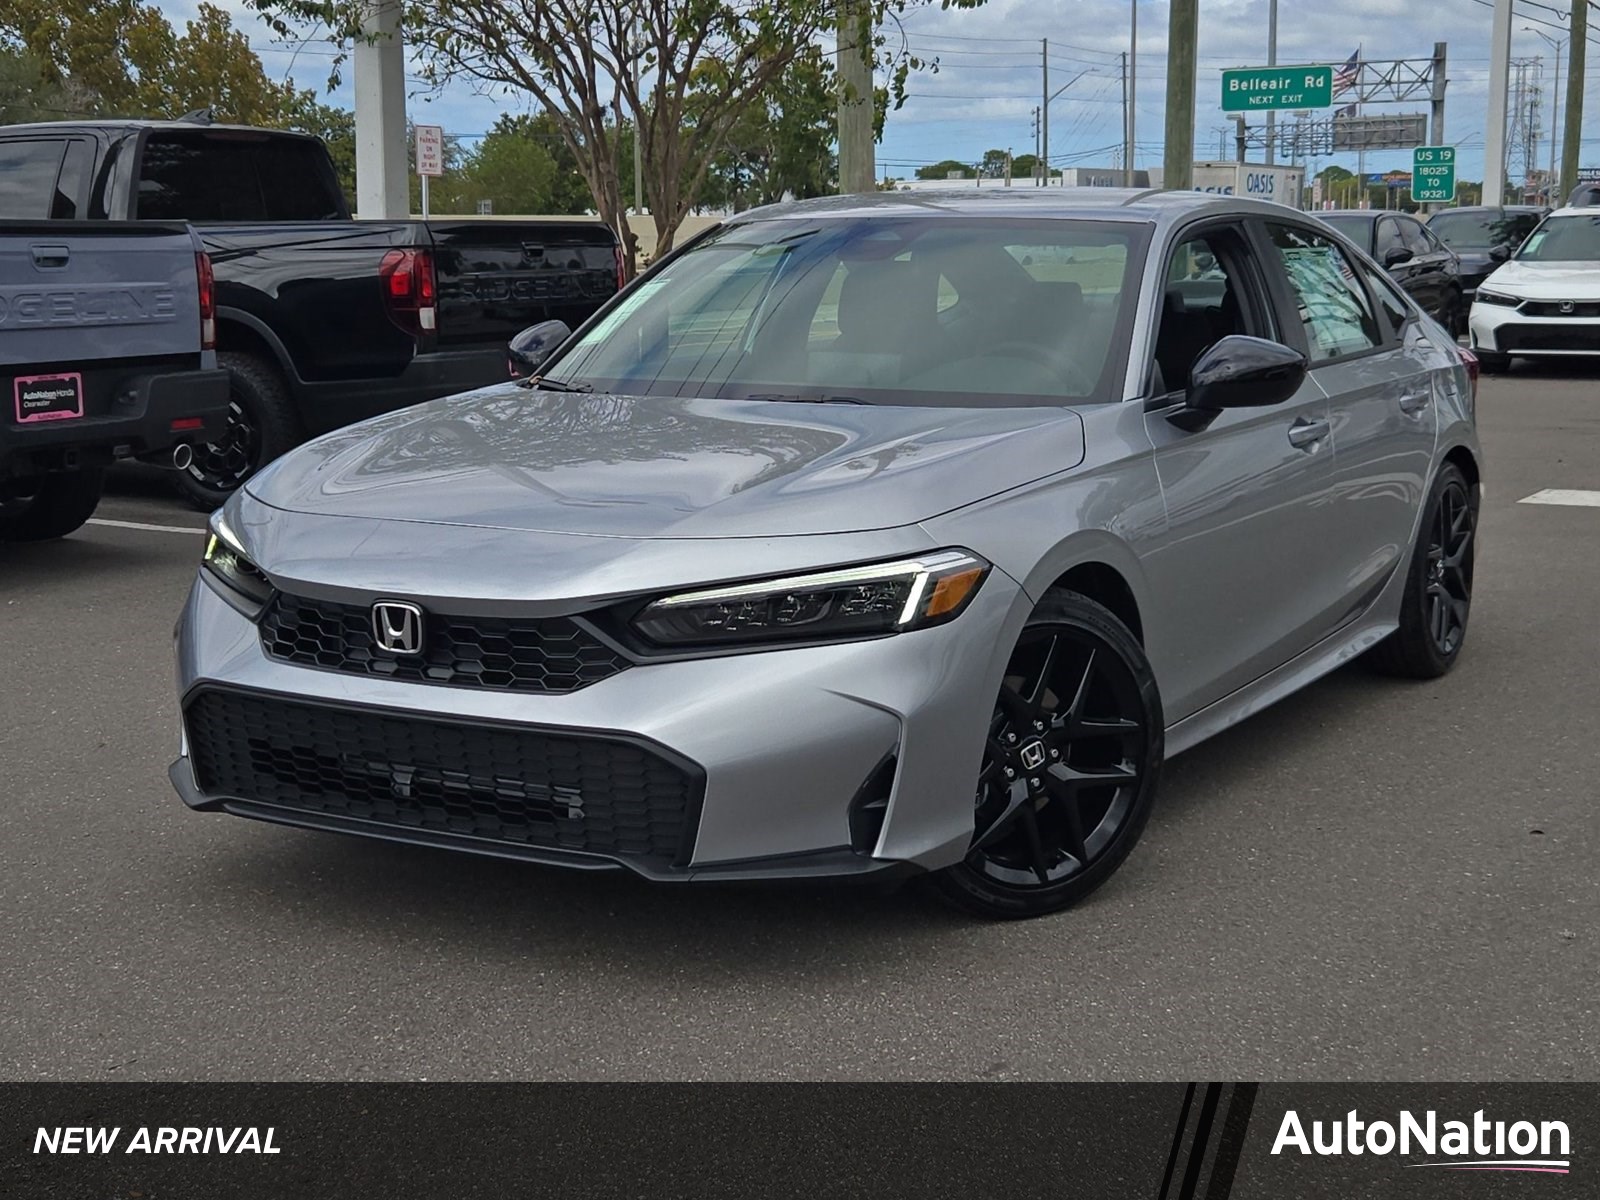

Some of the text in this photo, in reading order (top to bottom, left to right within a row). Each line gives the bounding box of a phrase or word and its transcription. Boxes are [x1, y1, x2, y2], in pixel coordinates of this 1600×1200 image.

[1229, 75, 1325, 91] Belleair Rd
[1249, 94, 1303, 105] NEXT EXIT
[1417, 151, 1452, 160] US 19
[1419, 167, 1449, 175] 18025
[1246, 173, 1274, 193] OASIS
[1427, 178, 1440, 187] TO
[1419, 190, 1446, 198] 19321
